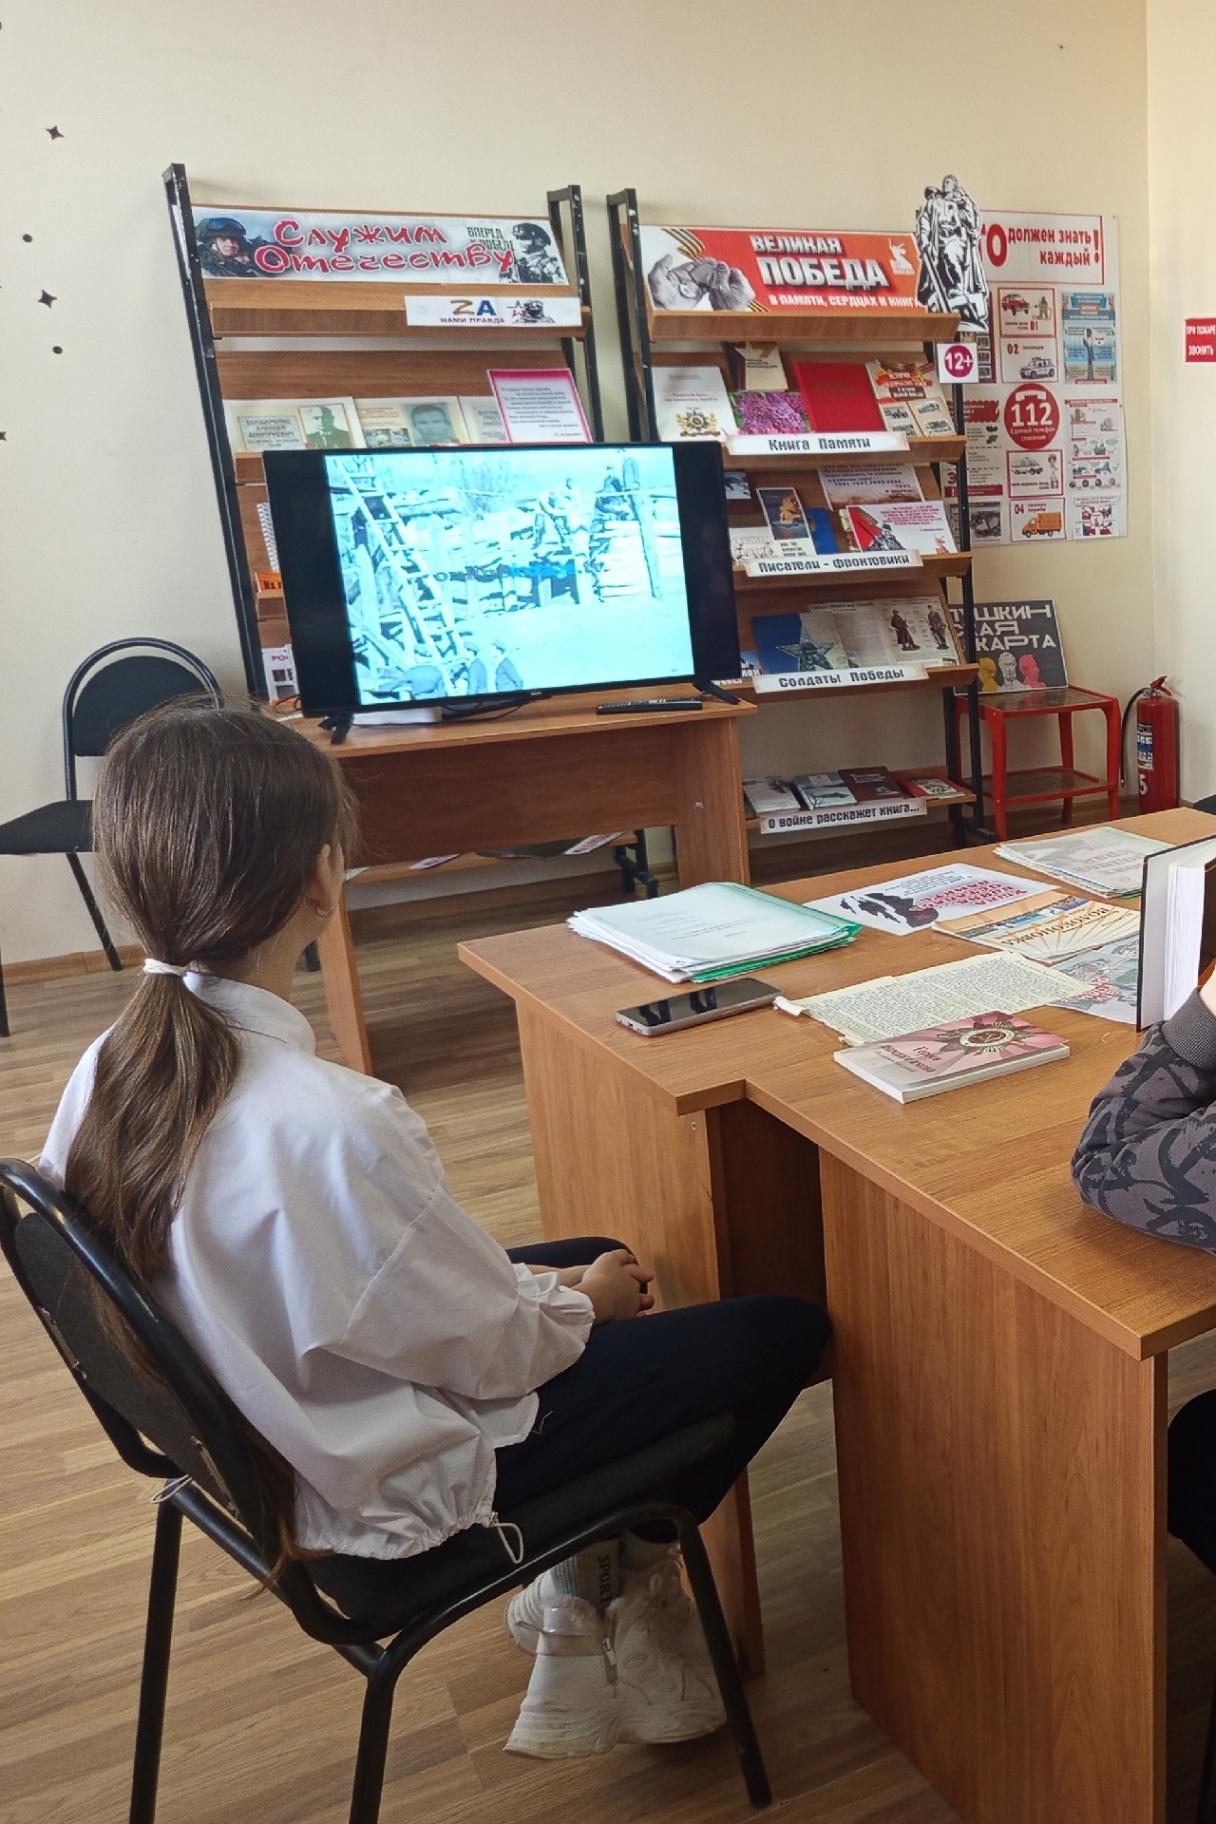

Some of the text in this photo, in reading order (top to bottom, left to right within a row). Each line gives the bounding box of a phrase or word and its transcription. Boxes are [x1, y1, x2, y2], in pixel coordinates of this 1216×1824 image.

[274, 218, 447, 251] Служим
[751, 235, 842, 253] ВЕЛИКАЯ
[1008, 227, 1055, 244] должен
[1059, 230, 1092, 245] знать
[254, 243, 515, 275] Отечеству
[1040, 247, 1091, 268] каждый
[756, 256, 889, 290] ПОБЕДА
[768, 294, 778, 305] В
[779, 295, 827, 307] ПАМЯТИ,
[829, 295, 877, 309] СЕРДЦАХ
[879, 297, 887, 306] И
[1007, 343, 1019, 355] 02
[944, 352, 974, 371] 12+
[1011, 402, 1053, 427] 112
[768, 437, 871, 452] Книга Памяти
[1014, 504, 1025, 514] 04
[758, 556, 821, 573] Писатели
[832, 553, 910, 570] фронтовики
[975, 634, 1057, 652] КАРТА
[778, 667, 905, 688] Солдаты Победы
[768, 803, 920, 829] О войне расскажет книга...
